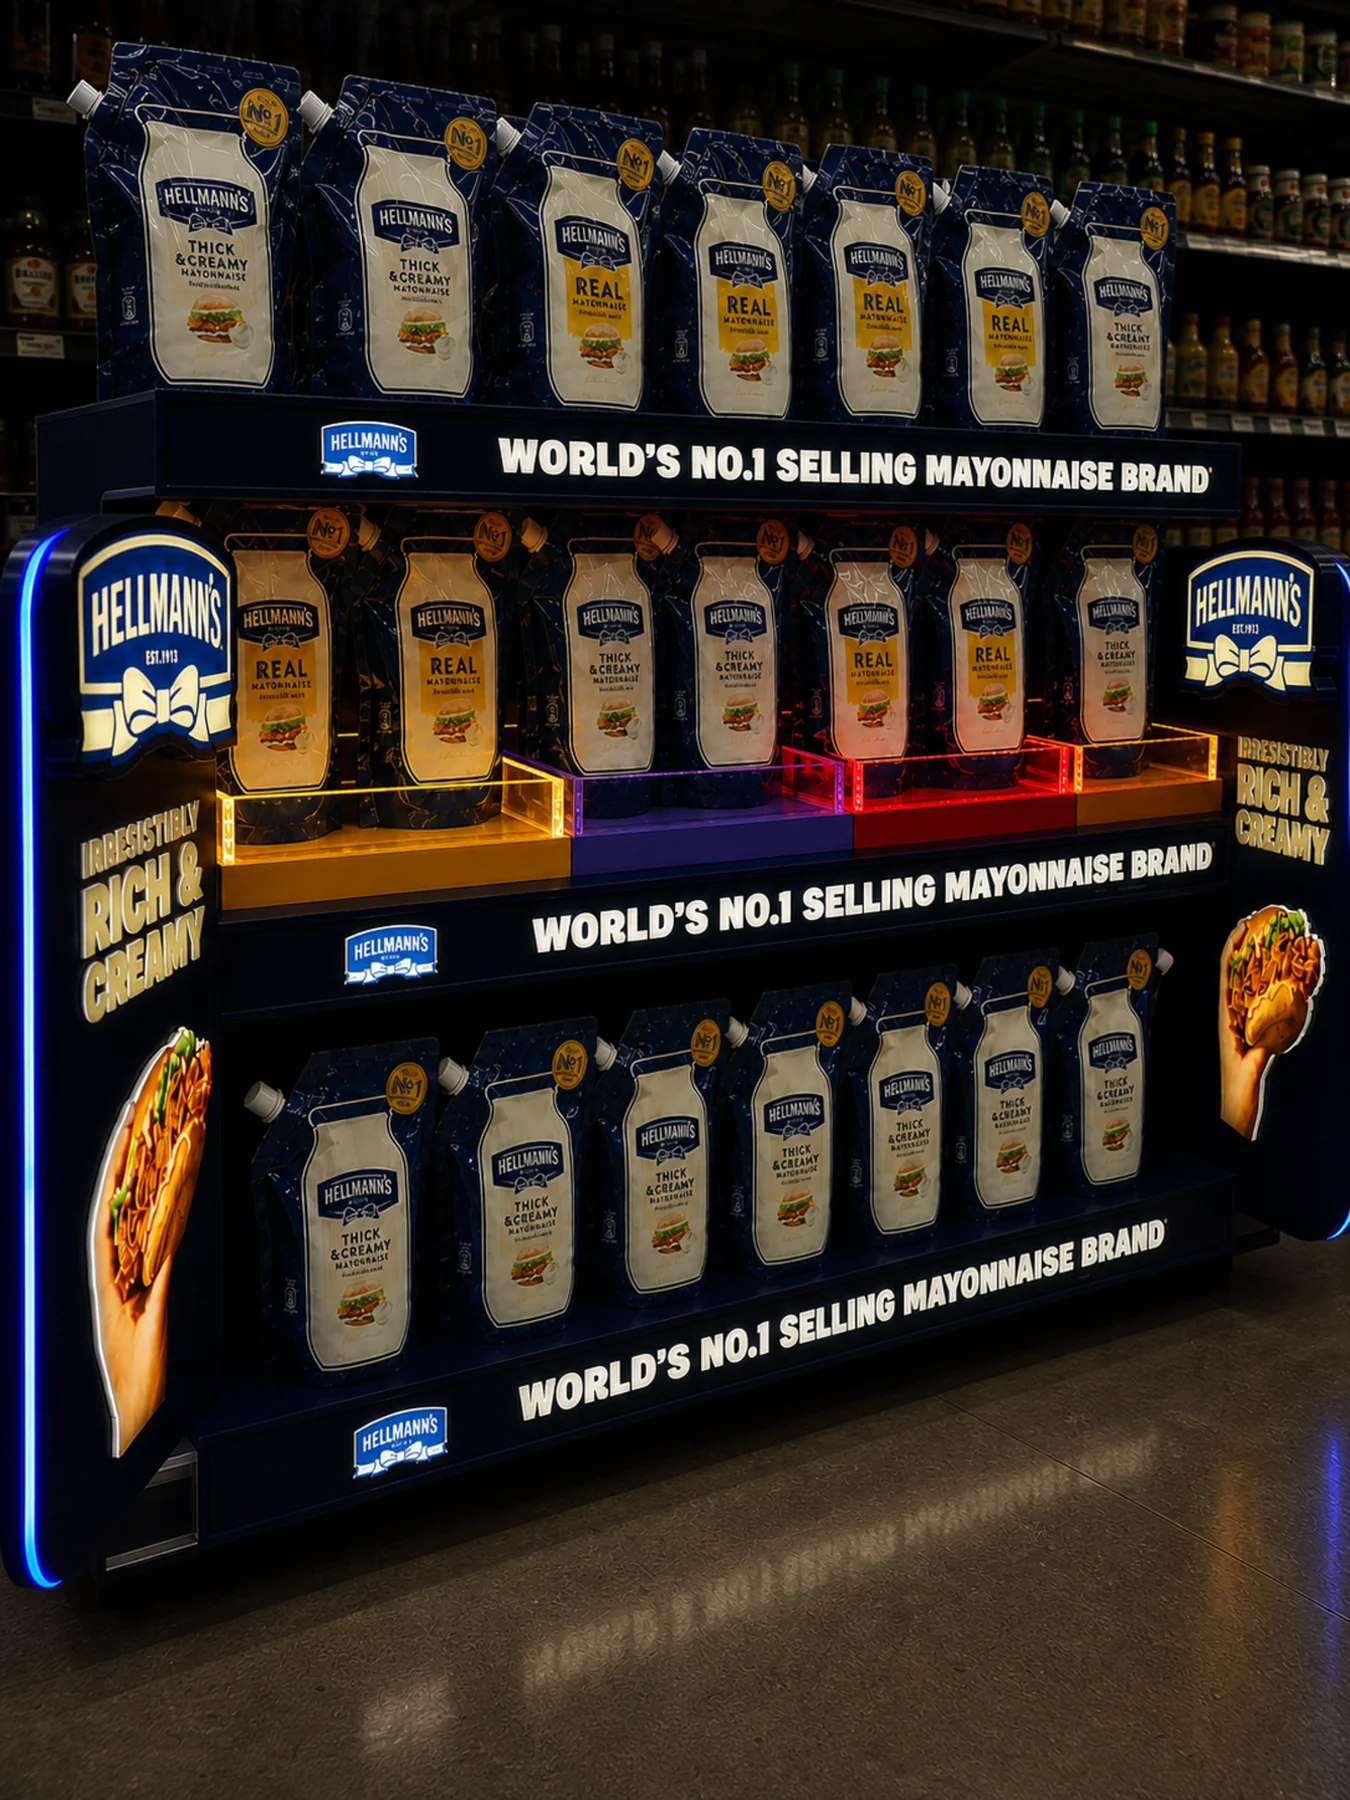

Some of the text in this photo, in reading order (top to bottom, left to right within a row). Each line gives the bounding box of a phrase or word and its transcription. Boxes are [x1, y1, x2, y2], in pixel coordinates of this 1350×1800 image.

[165, 187, 249, 213] HELLMANN'S
[380, 210, 452, 233] HELLMANN'S
[188, 240, 235, 255] THICK
[562, 226, 626, 253] HELLMANN'S
[400, 259, 440, 272] THICK
[576, 277, 623, 300] REAL
[727, 296, 771, 316] REAL
[864, 293, 904, 313] REAL
[992, 315, 1029, 332] REAL
[1115, 323, 1142, 332] THICK
[331, 432, 408, 453] HELLMANN'S
[498, 436, 681, 480] WORLD'S
[692, 444, 765, 481] NO.1
[775, 447, 916, 486] SELLING
[925, 454, 1113, 491] MAYONNAISE
[1196, 572, 1302, 628] HELLMANN'S
[92, 572, 222, 658] HELLMANN'S
[243, 607, 313, 629] HELLMANN'S
[417, 608, 480, 628] HELLMANN'S
[725, 651, 754, 661] THICK
[976, 647, 1010, 662] REAL
[1105, 641, 1129, 650] THICK
[431, 656, 477, 675] REAL
[599, 653, 632, 663] THICK
[854, 651, 892, 668] REAL
[256, 659, 307, 679] REAL
[1237, 736, 1330, 772] IRRESISTIBLY
[1236, 763, 1329, 823] RICH &
[81, 799, 200, 880] IRRESISTIBLY
[1235, 808, 1330, 866] CREAMY
[81, 840, 204, 960] RICH &
[532, 899, 709, 954] WORLD'S
[719, 889, 792, 931] NO.1
[802, 873, 936, 921] SELLING
[945, 852, 1124, 904] MAYONNAISE
[354, 932, 429, 961] HELLMANN'S
[82, 905, 206, 1024] CREAMY
[1104, 1076, 1128, 1089] THICK
[769, 1098, 821, 1123] HELLMANN'S
[1000, 1097, 1025, 1109] THICK
[641, 1121, 696, 1147] HELLMANN'S
[896, 1118, 923, 1132] THICK
[498, 1146, 559, 1175] HELLMANN'S
[782, 1144, 811, 1158] THICK
[656, 1167, 687, 1183] THICK
[324, 1174, 392, 1205] HELLMANN'S
[514, 1196, 549, 1212] THICK
[342, 1227, 380, 1246] THICK
[518, 1343, 691, 1422] WORLD'S
[701, 1320, 770, 1372] NO.1
[779, 1288, 896, 1349] SELLING
[903, 1241, 1074, 1316] MAYONNAISE
[363, 1413, 438, 1453] HELLMANN'S
